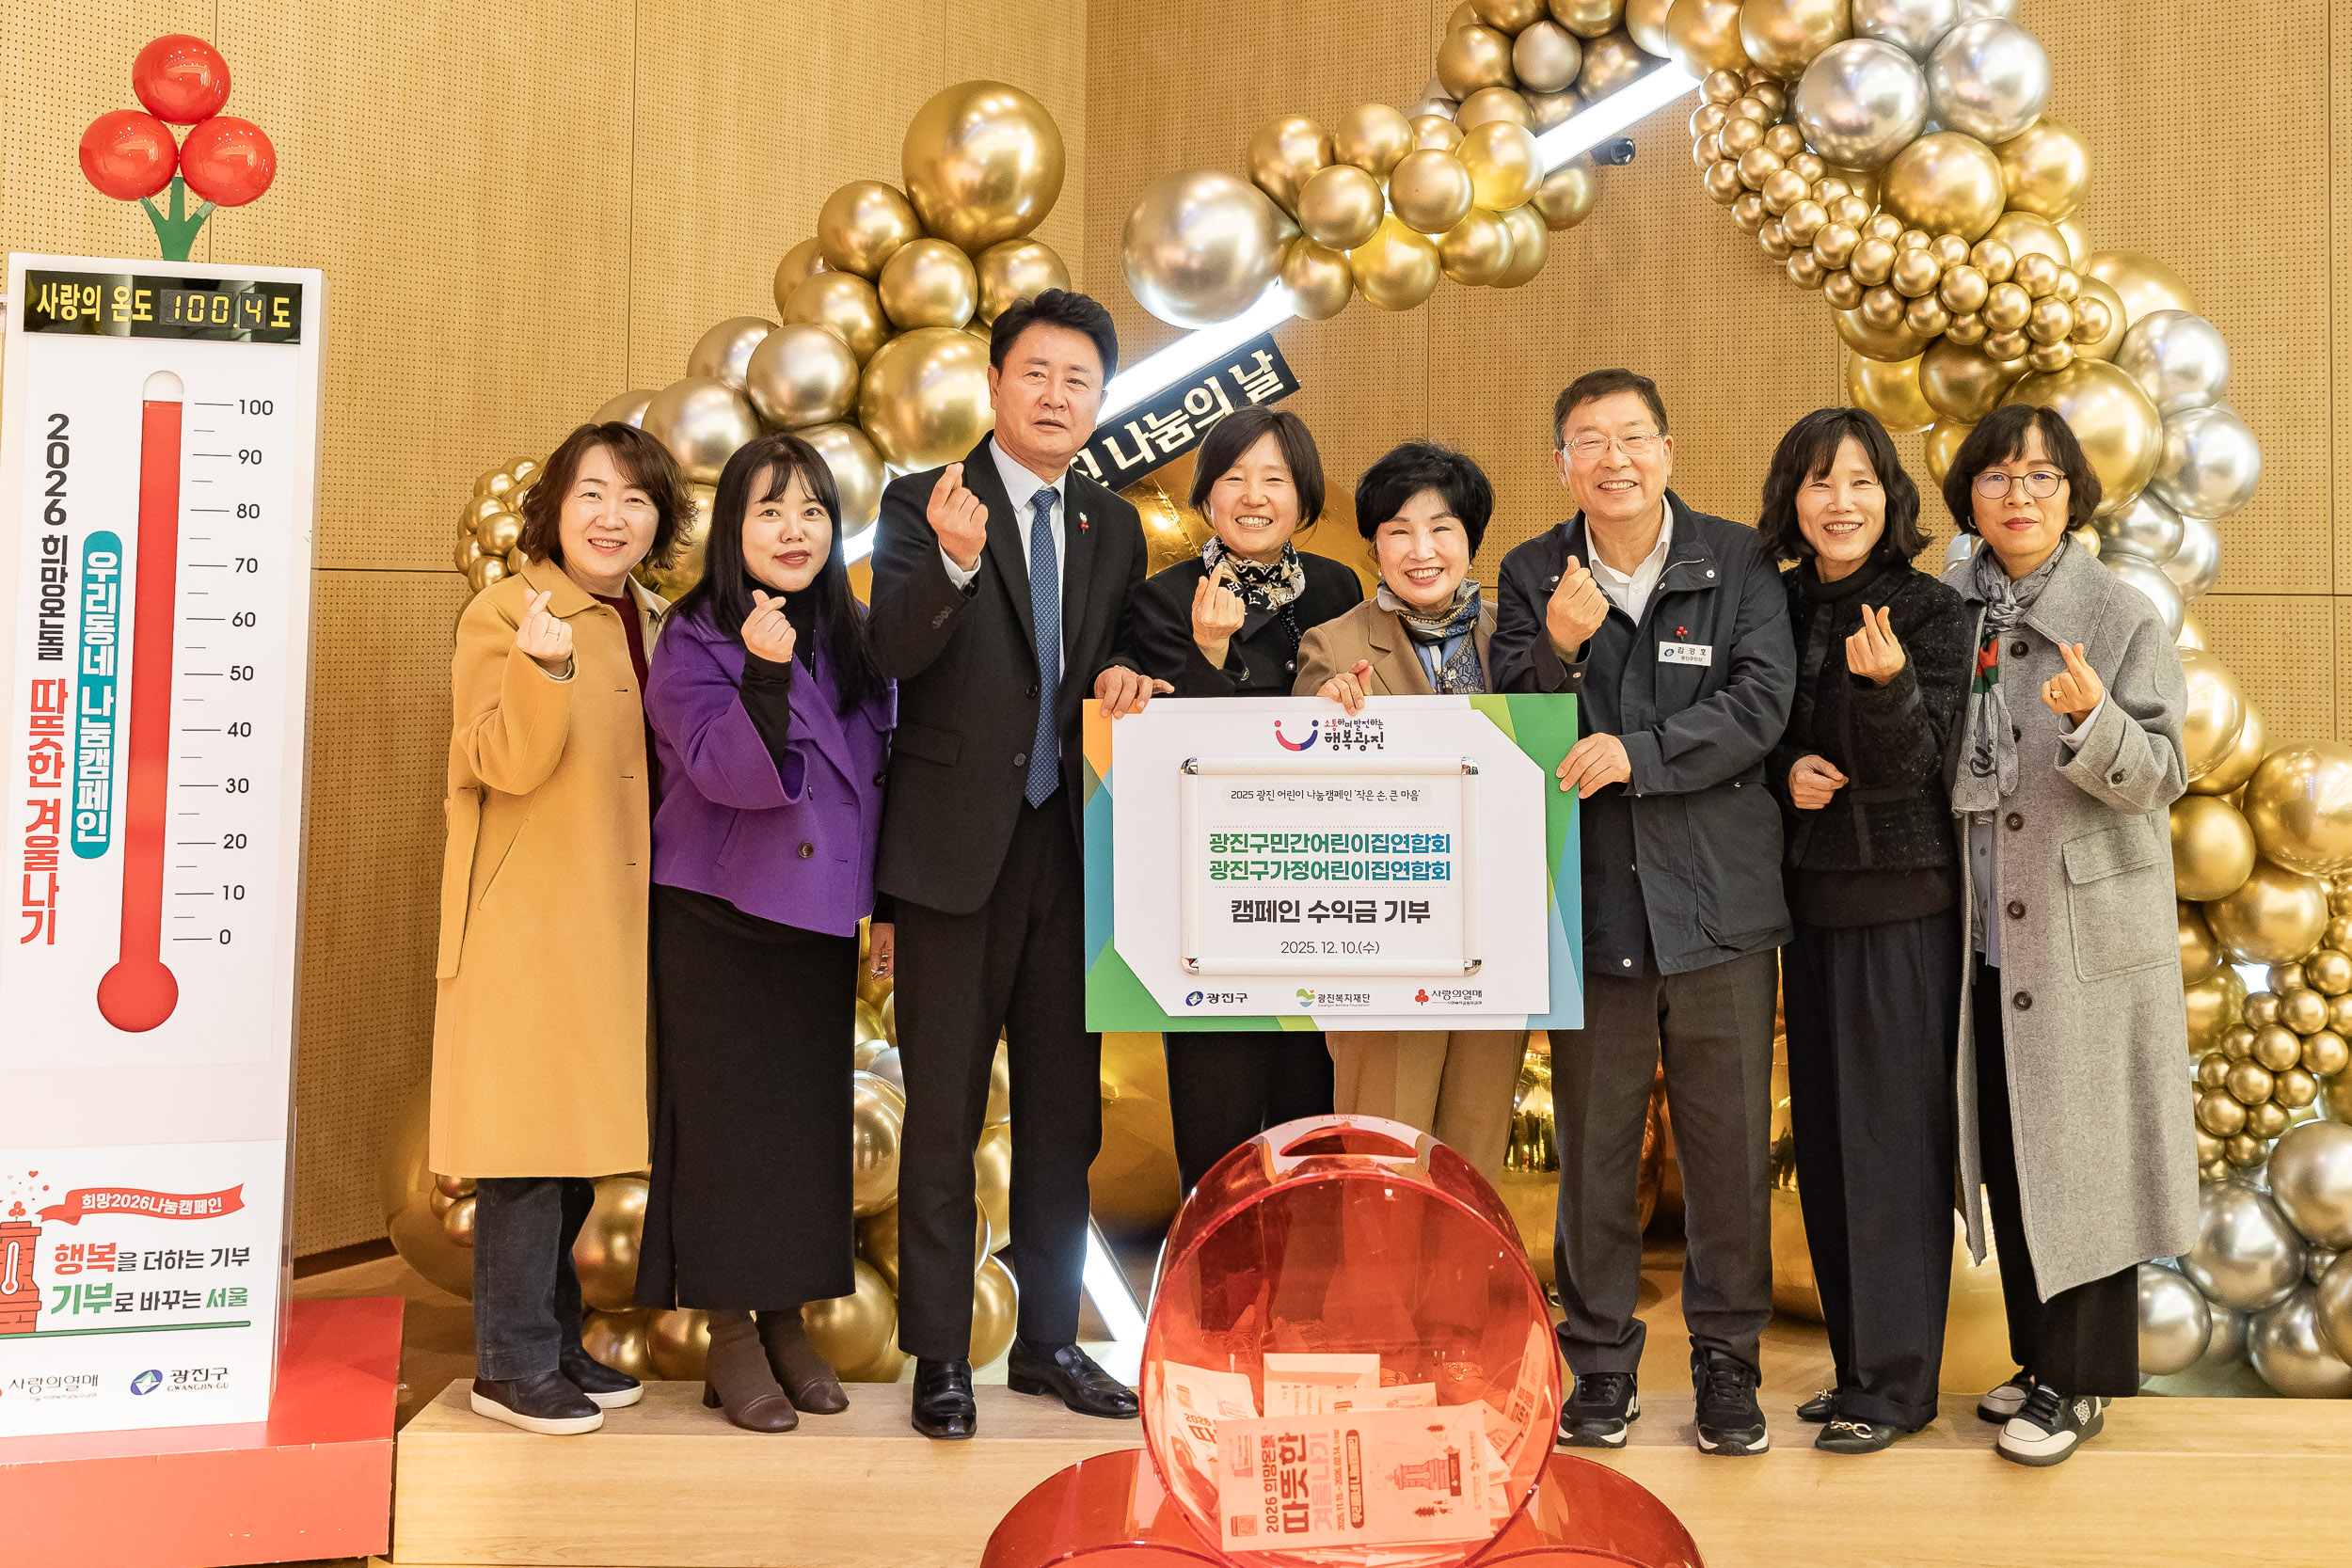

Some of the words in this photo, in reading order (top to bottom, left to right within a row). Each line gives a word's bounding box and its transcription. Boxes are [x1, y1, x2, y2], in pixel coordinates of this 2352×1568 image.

[37, 282, 102, 322] 사랑의
[111, 285, 153, 323] 온도
[173, 294, 262, 329] 100.4
[270, 296, 291, 328] 도
[239, 400, 273, 416] 100
[1102, 376, 1235, 470] 나눔의
[1228, 349, 1284, 404] 날
[238, 450, 262, 465] 90
[43, 413, 70, 526] 2026
[236, 503, 261, 519] 80
[235, 558, 258, 574] 70
[38, 534, 69, 661] 희망온돌
[82, 551, 119, 677] 우리동네
[232, 612, 256, 627] 60
[230, 666, 254, 681] 50
[28, 678, 69, 788] 따뜻한
[228, 722, 252, 737] 40
[1324, 719, 1353, 732] 소통하며
[1353, 719, 1384, 732] 발전하는
[1324, 730, 1384, 752] 행복광진
[76, 686, 114, 843] 나눔캠페인
[225, 779, 249, 793] 30
[1231, 790, 1254, 800] 2025
[1256, 789, 1275, 801] 광진
[1277, 789, 1304, 801] 어린이
[1307, 789, 1353, 801] 나눔캠페인
[1376, 790, 1388, 801] 손,
[1389, 790, 1399, 801] 큰
[223, 834, 247, 849] 20
[1210, 833, 1451, 854] 광진구민간어린이집연합회
[21, 799, 60, 945] 겨울나기
[1210, 860, 1451, 881] 광진구가정어린이집연합회
[223, 885, 245, 900] 10
[1232, 900, 1300, 923] 캠페인
[1308, 899, 1377, 924] 수익금
[1385, 900, 1431, 924] 기부
[219, 930, 231, 944] 0
[1280, 941, 1318, 954] 2025.
[1321, 941, 1338, 954] 12.
[1342, 941, 1380, 955] 10.(수)
[1206, 993, 1248, 1004] 광진구
[1318, 993, 1370, 1004] 광진복지재단
[1432, 990, 1483, 1001] 사랑의열매
[81, 1194, 222, 1216] 희망2026나눔캠페인
[55, 1243, 137, 1275] 행복을
[143, 1249, 204, 1271] 더하는
[210, 1246, 250, 1268] 기부
[51, 1282, 134, 1315] 기부로
[140, 1290, 201, 1311] 바꾸는
[206, 1287, 248, 1308] 서울
[8, 1374, 99, 1394] 사랑의열매
[169, 1368, 229, 1384] 광진구
[1279, 1433, 1310, 1533] 따뜻한
[1309, 1433, 1332, 1530] 겨울나기
[1265, 1497, 1279, 1533] 2026
